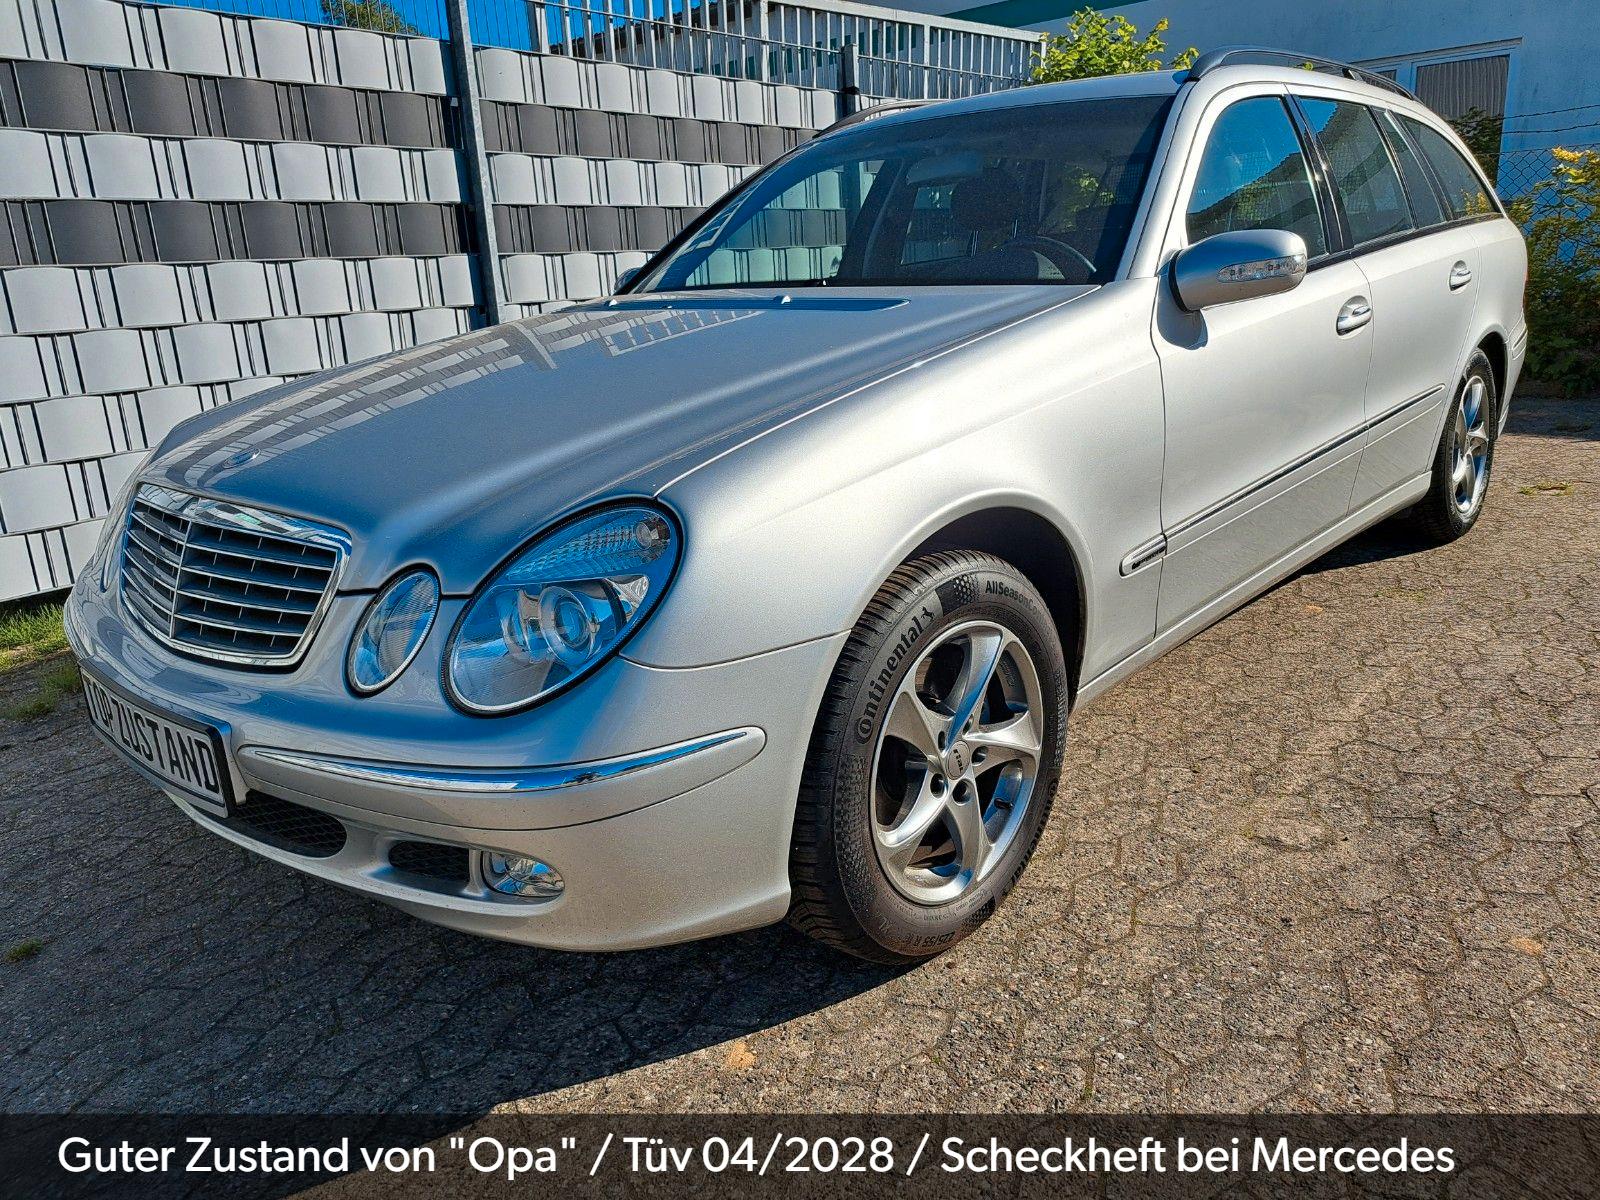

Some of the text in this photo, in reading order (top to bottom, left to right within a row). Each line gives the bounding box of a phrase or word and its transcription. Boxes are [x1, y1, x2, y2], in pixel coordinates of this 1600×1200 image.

[82, 675, 220, 795] TOP ZUSTAND
[854, 615, 925, 745] Continental
